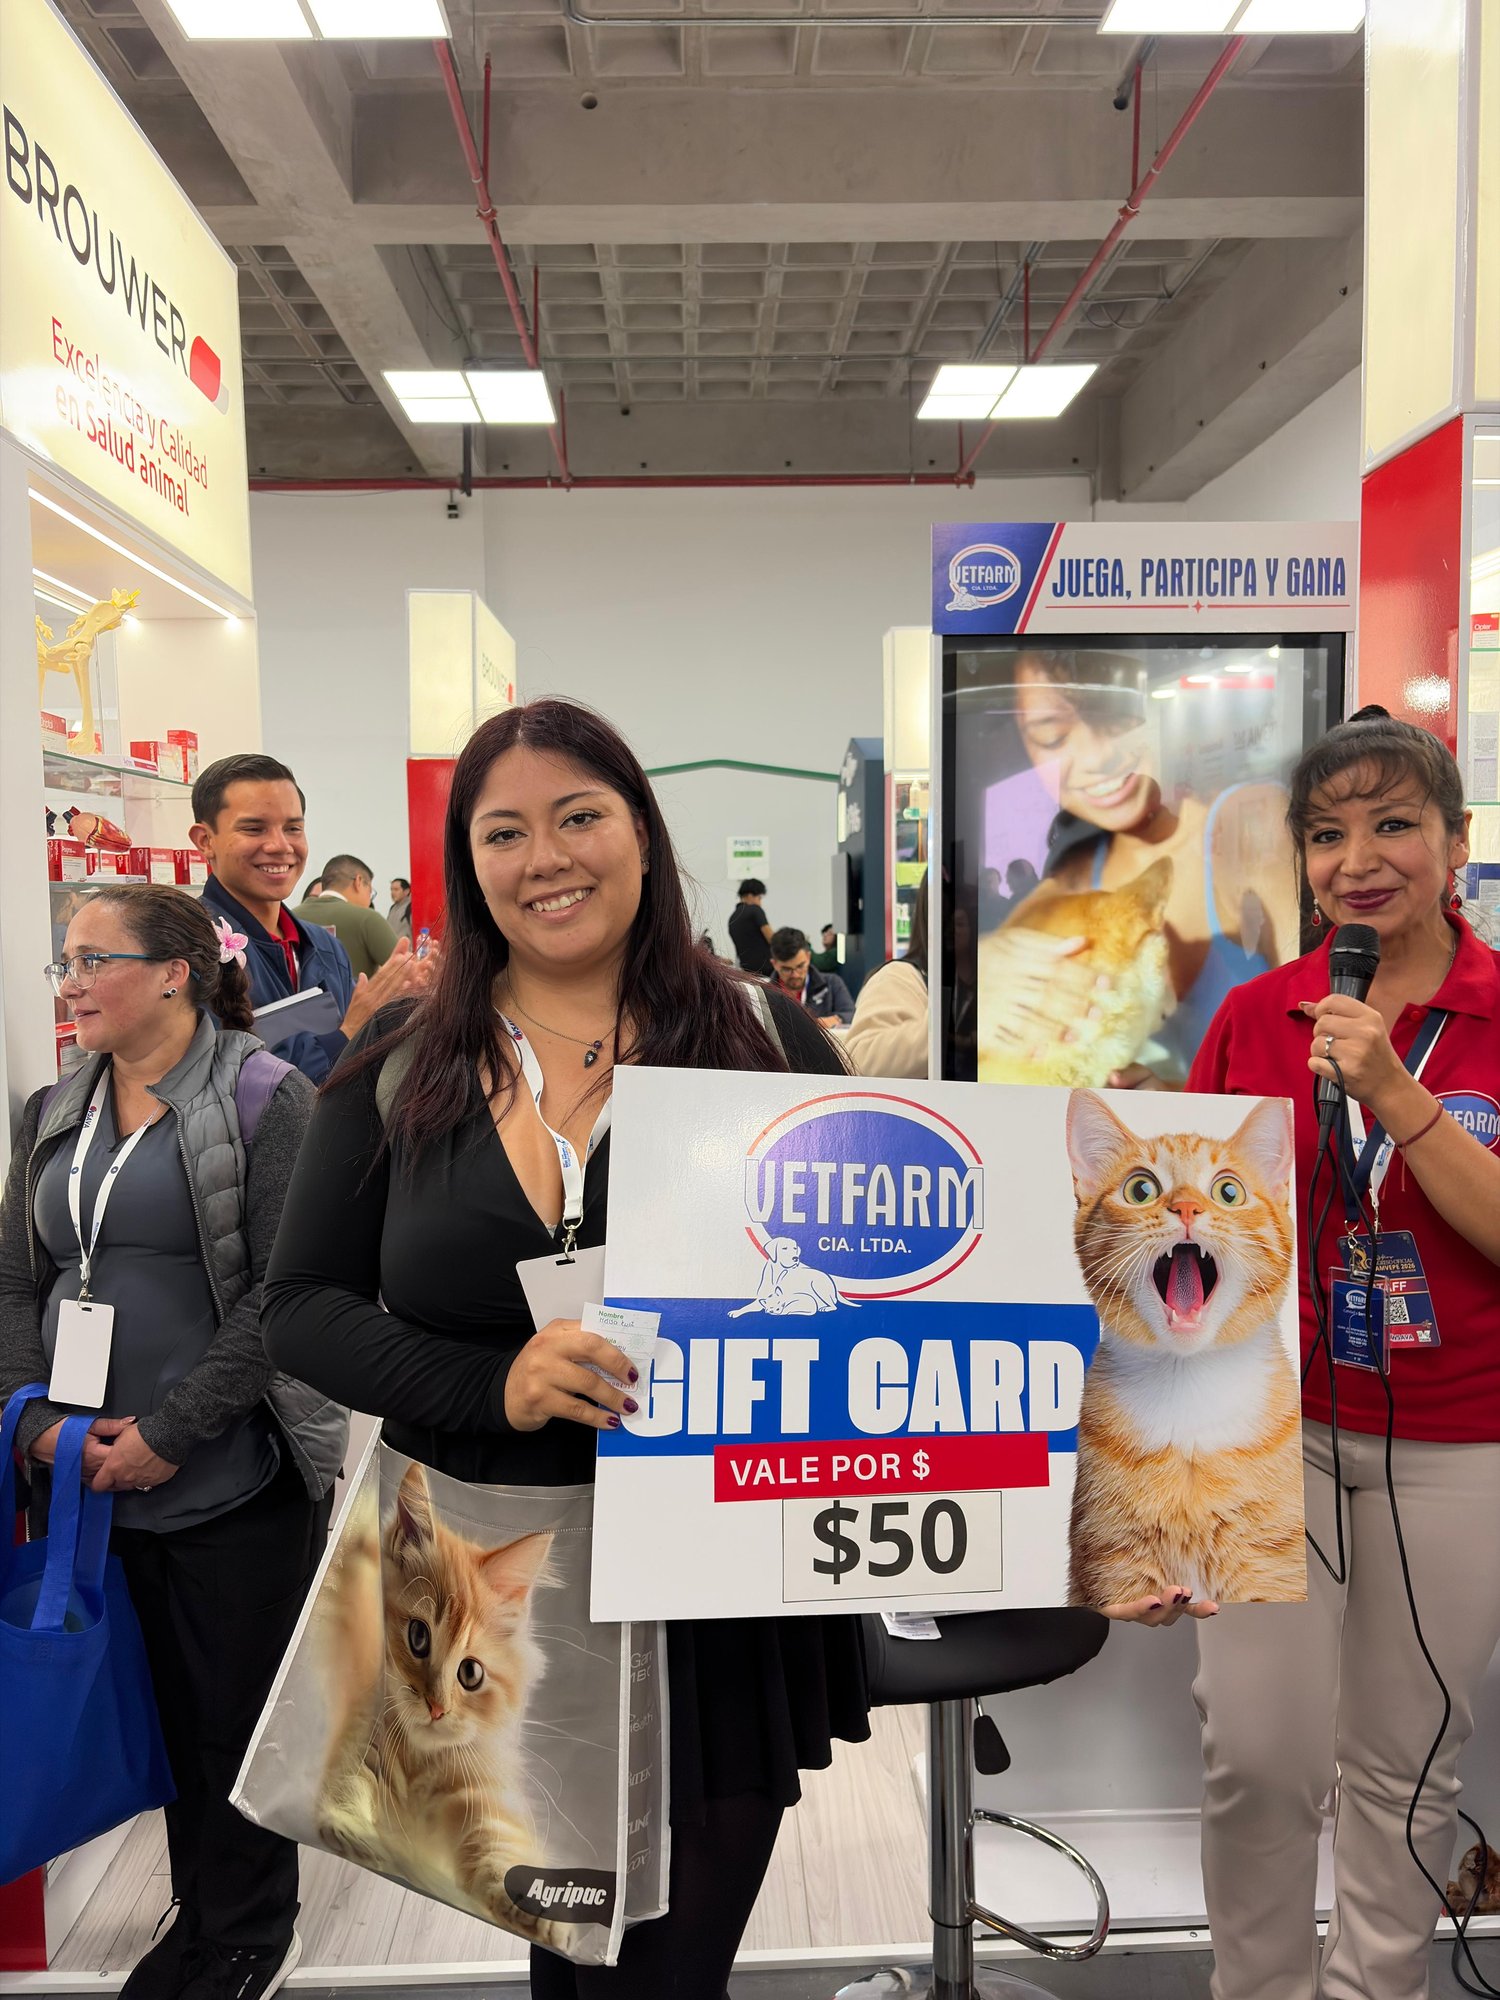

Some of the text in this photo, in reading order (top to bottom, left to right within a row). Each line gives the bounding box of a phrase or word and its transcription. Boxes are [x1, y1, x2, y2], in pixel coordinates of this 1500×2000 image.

[3, 104, 189, 378] BROUWER
[52, 316, 208, 490] Excelencia y Calidad
[56, 385, 189, 517] en Salud animal
[951, 565, 1020, 584] VETFARM
[1052, 557, 1346, 600] JUEGA, PARTICIPA Y GANA
[745, 1157, 984, 1230] VETFARM
[818, 1236, 912, 1254] CIA. LTDA.
[598, 1310, 624, 1319] Nombre
[619, 1337, 1085, 1438] GIFT CARD
[729, 1448, 930, 1486] VALE POR $
[811, 1498, 969, 1585] $50
[526, 1878, 607, 1908] Agripac
